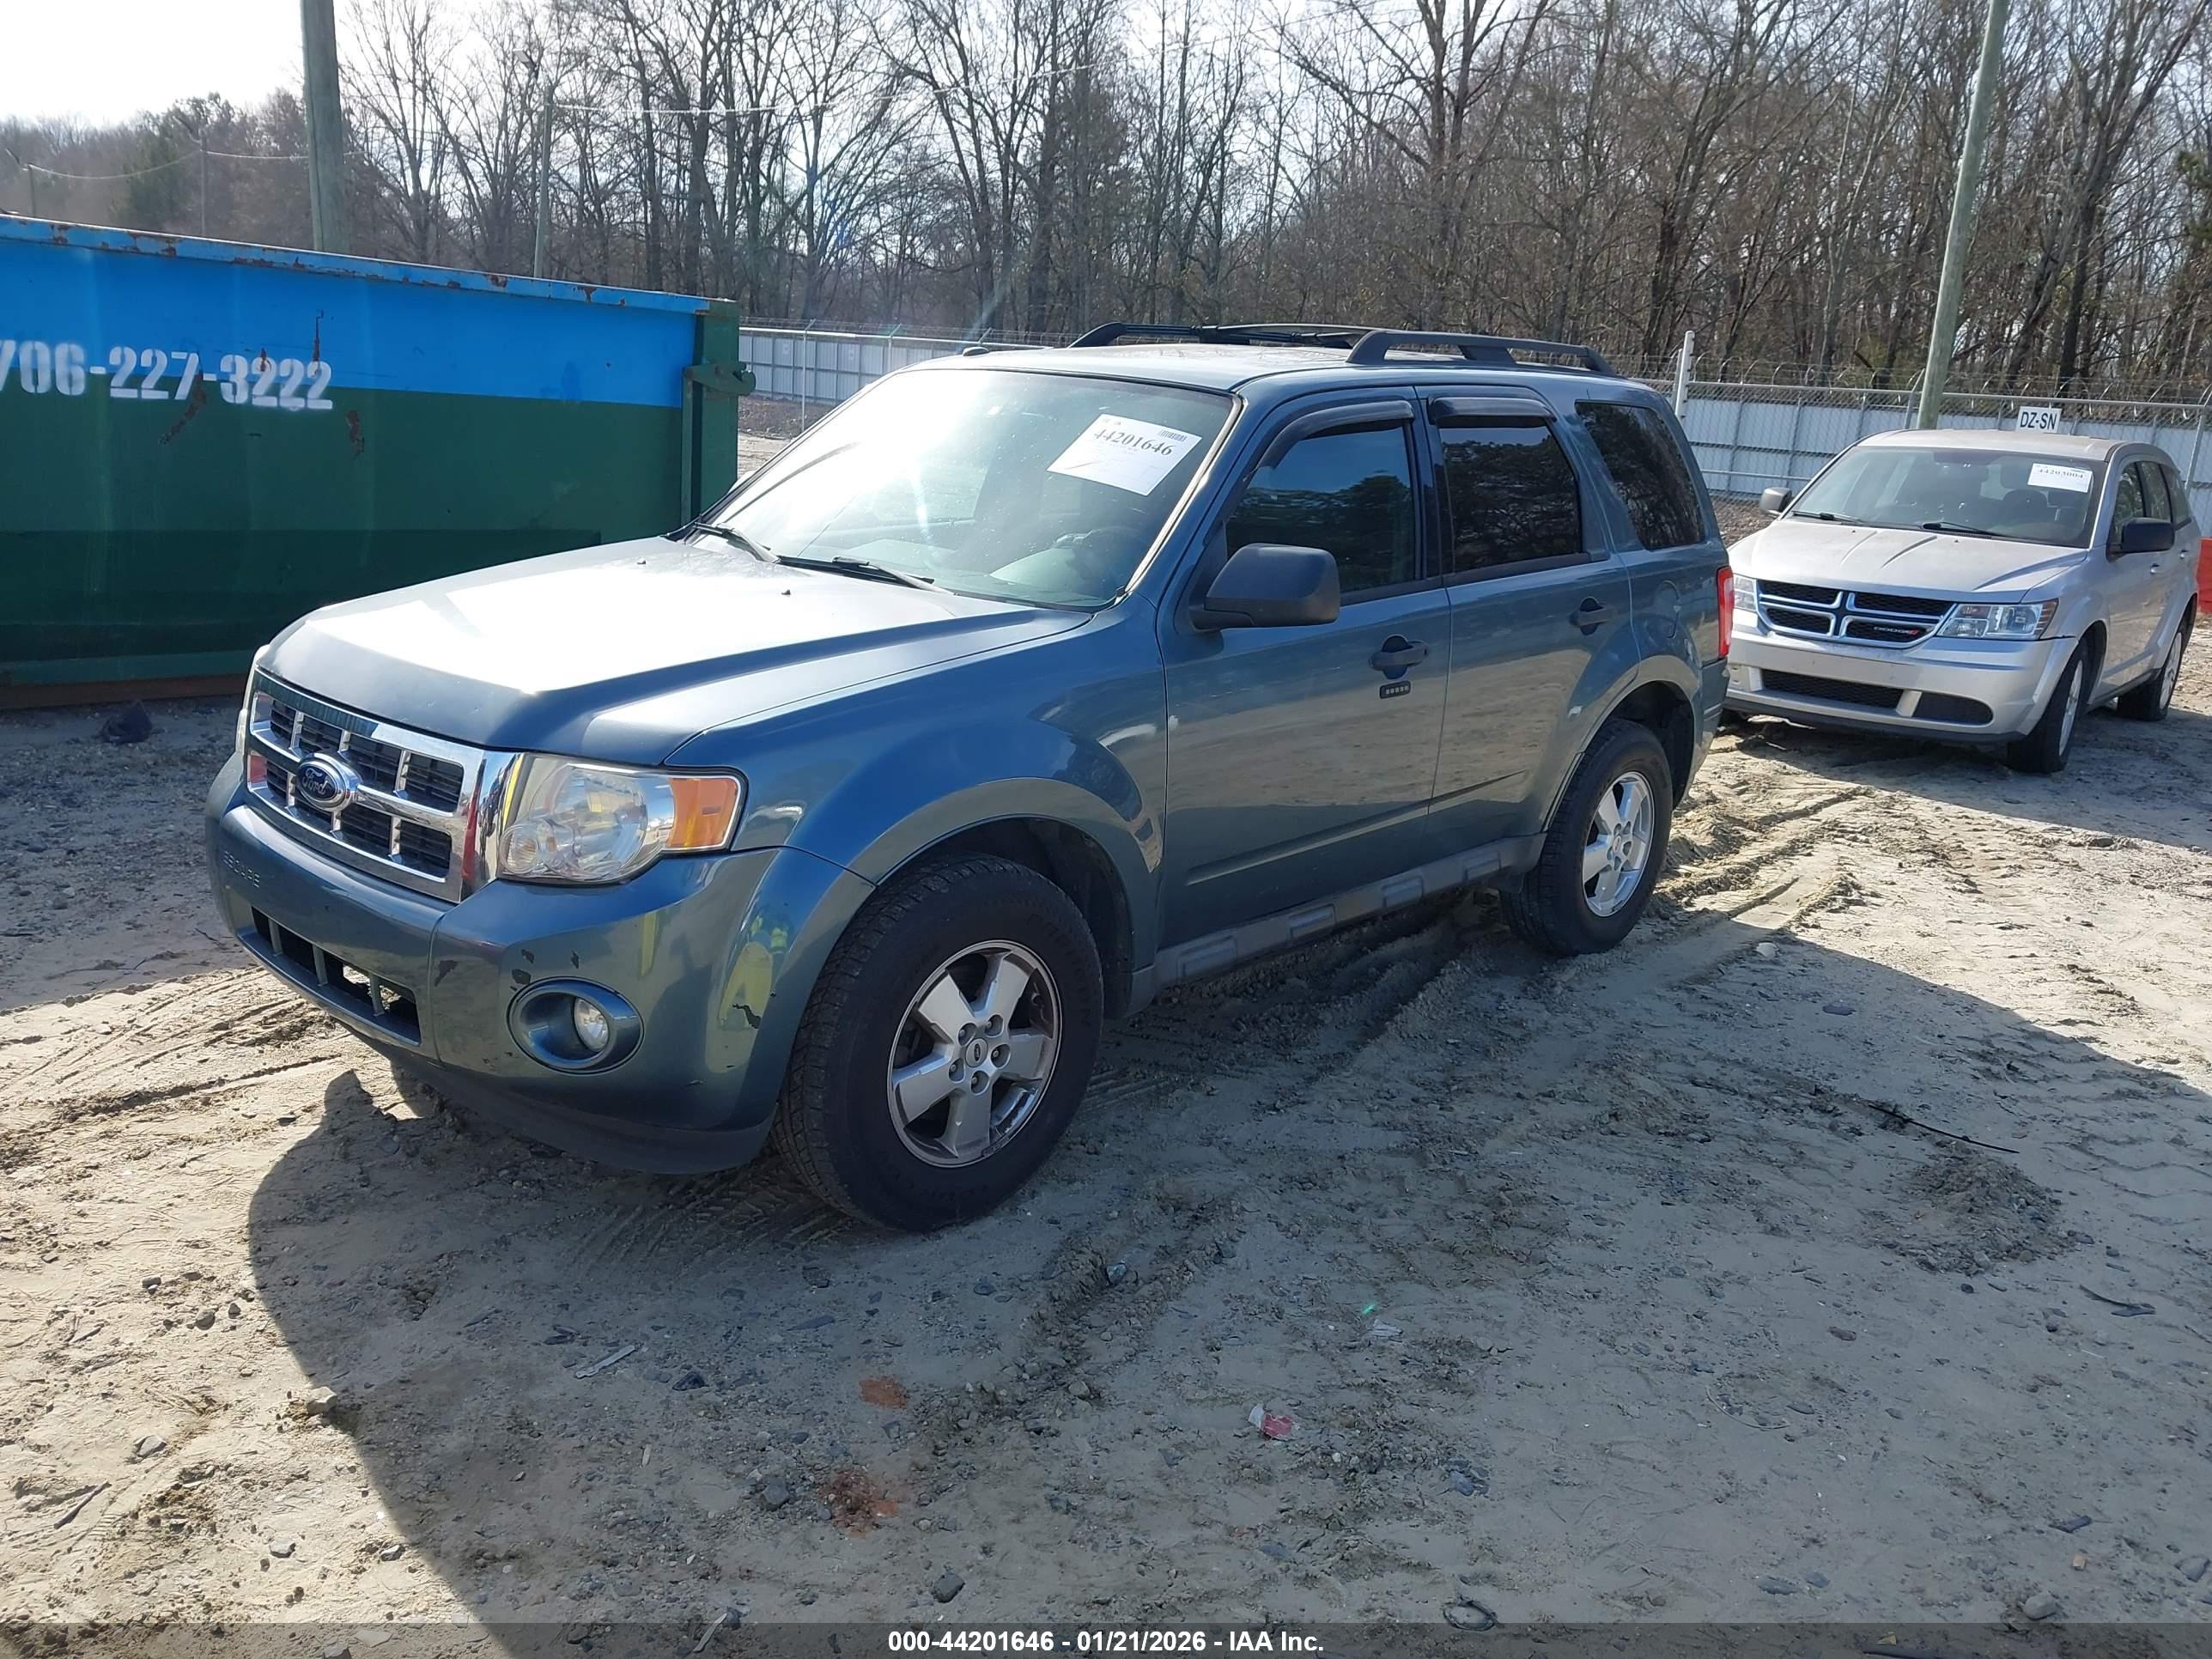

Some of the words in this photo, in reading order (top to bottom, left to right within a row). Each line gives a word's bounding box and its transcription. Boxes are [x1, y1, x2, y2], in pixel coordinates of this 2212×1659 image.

[0, 339, 333, 410] 706-227-3222
[2020, 411, 2057, 430] DZ-SN
[1094, 428, 1176, 456] 44201646
[301, 768, 329, 795] Ford
